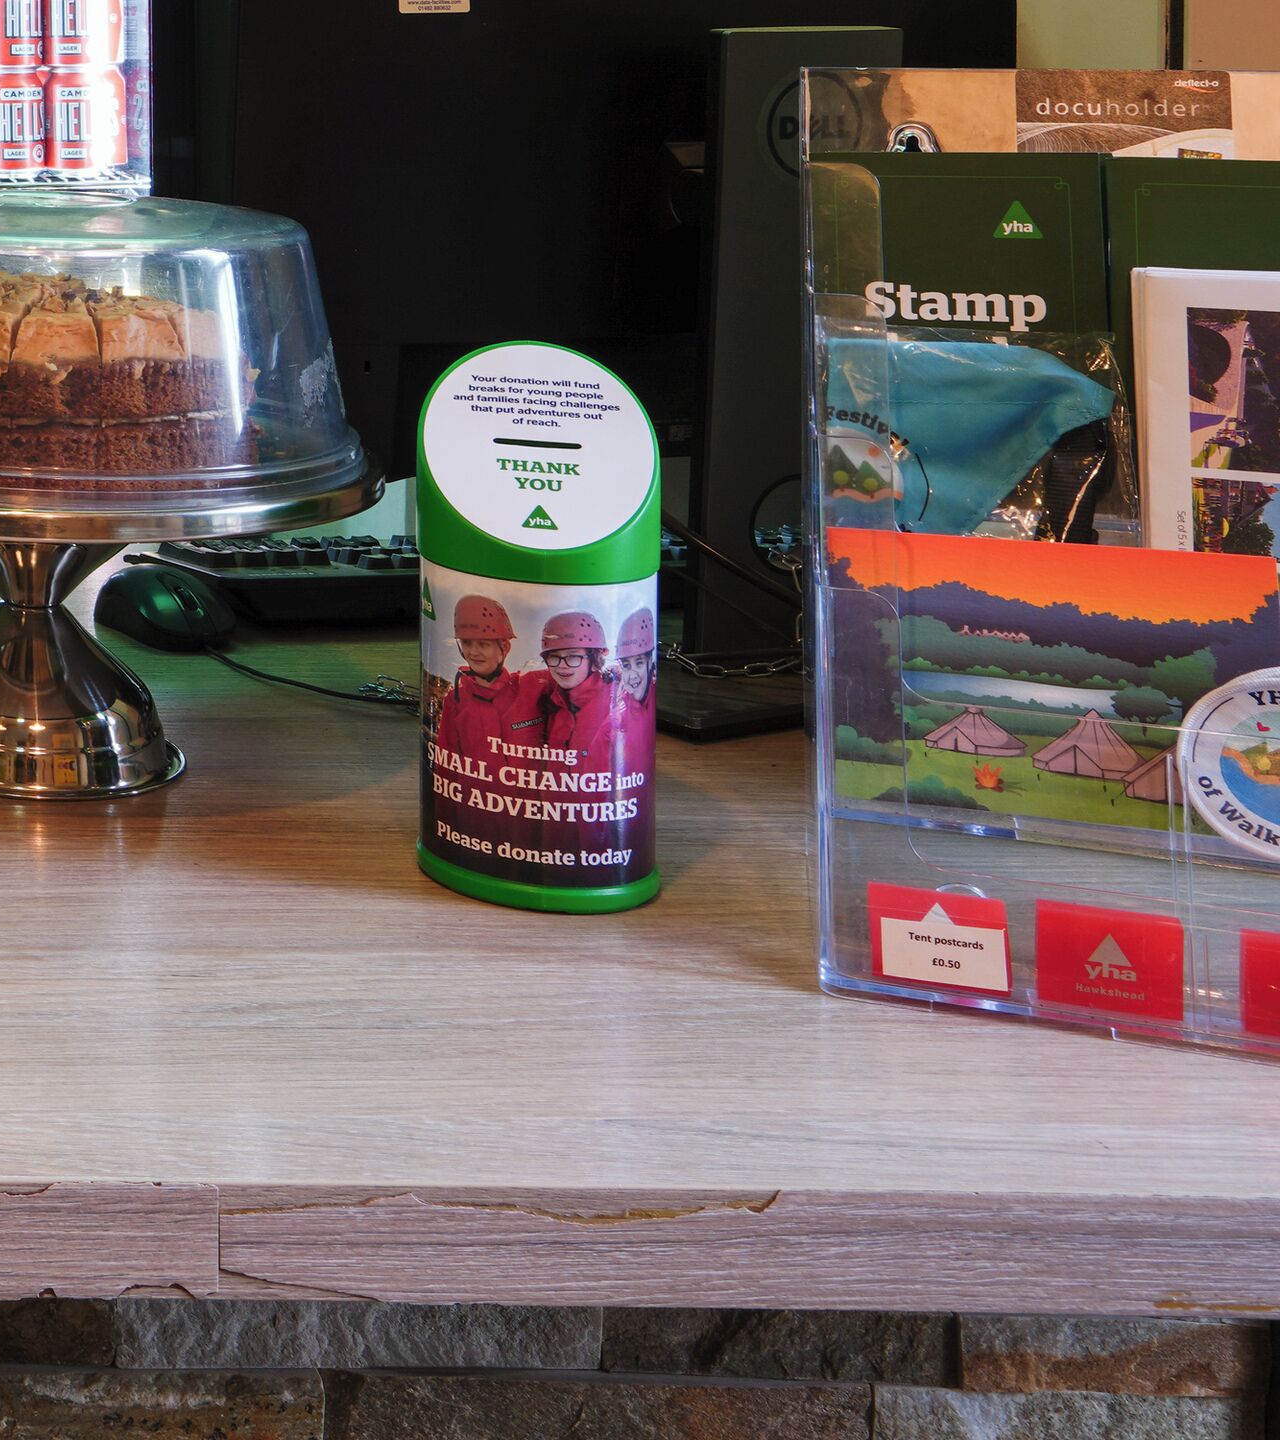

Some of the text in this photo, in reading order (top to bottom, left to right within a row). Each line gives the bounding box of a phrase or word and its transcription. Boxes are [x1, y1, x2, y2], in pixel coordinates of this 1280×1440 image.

[1174, 79, 1219, 88] deflect-o
[1035, 98, 1200, 117] docuholder
[1001, 220, 1034, 235] yha
[864, 279, 1048, 334] Stamp
[470, 374, 600, 390] Your donation will fund
[468, 384, 604, 401] breaks for young people
[453, 393, 620, 412] and families facing challenges
[470, 403, 603, 420] that put adventures out
[512, 417, 561, 428] of reach.
[496, 458, 581, 476] THANK
[514, 477, 563, 492] YOU
[528, 517, 552, 527] yha
[487, 736, 578, 766] Turning
[427, 741, 645, 793] SMALL CHANGE into
[1197, 775, 1224, 799] of
[432, 773, 639, 824] BIG ADVENTURES
[436, 820, 633, 867] Please donate today
[908, 931, 985, 952] Tent postcards
[931, 957, 961, 970] £0.50
[1084, 961, 1137, 982] yha
[1074, 982, 1146, 1001] Hawkshead
